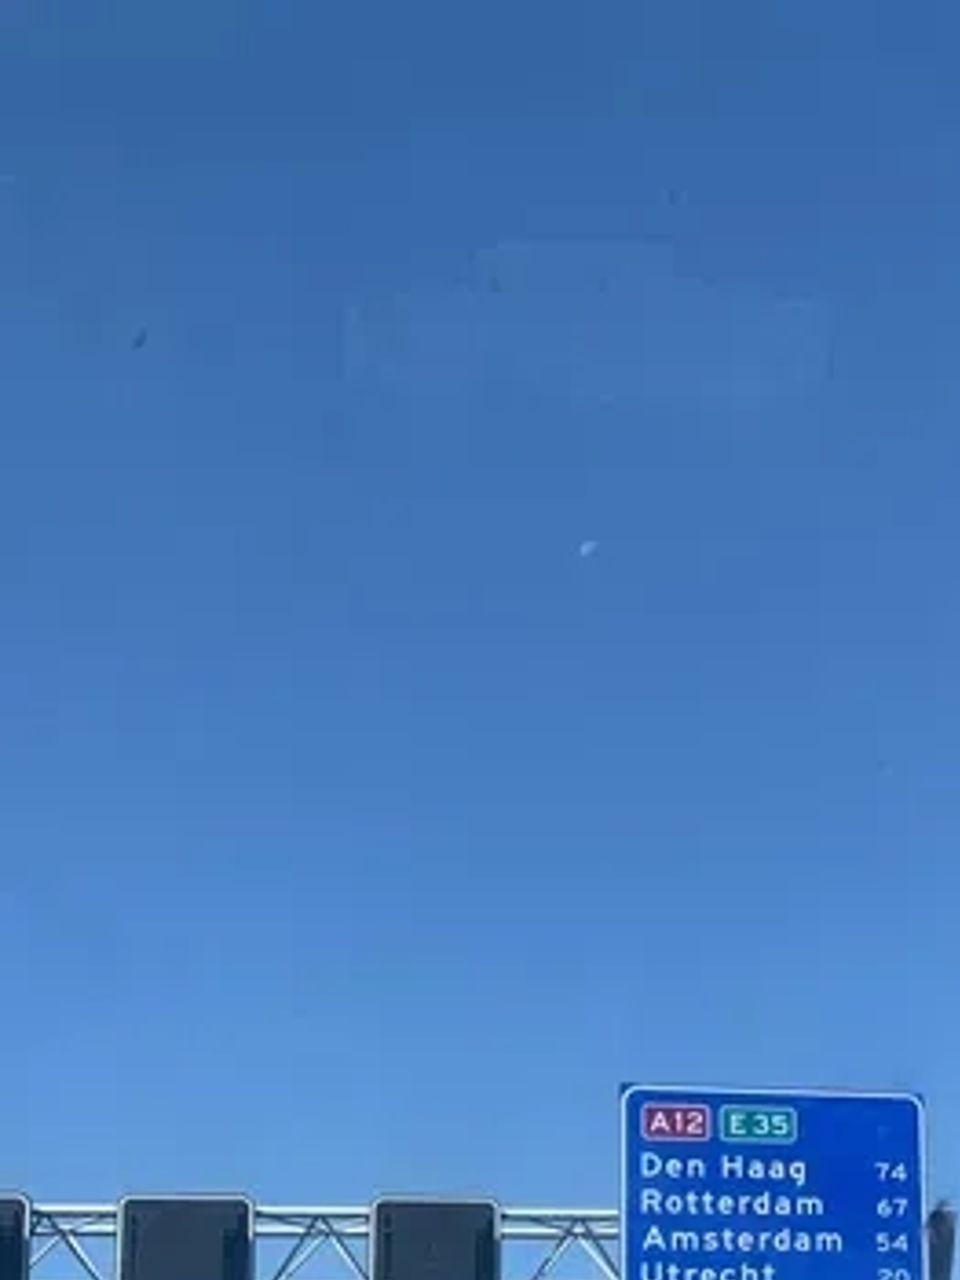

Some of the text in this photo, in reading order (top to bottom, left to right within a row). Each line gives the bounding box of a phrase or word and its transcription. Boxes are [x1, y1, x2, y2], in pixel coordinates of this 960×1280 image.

[650, 1111, 703, 1134] A12
[641, 1153, 806, 1185] Den Haag
[875, 1162, 908, 1181] 74
[641, 1189, 824, 1214] Rotterdam
[876, 1199, 908, 1217] 67
[643, 1226, 843, 1251] Amsterdam
[876, 1233, 908, 1251] 54
